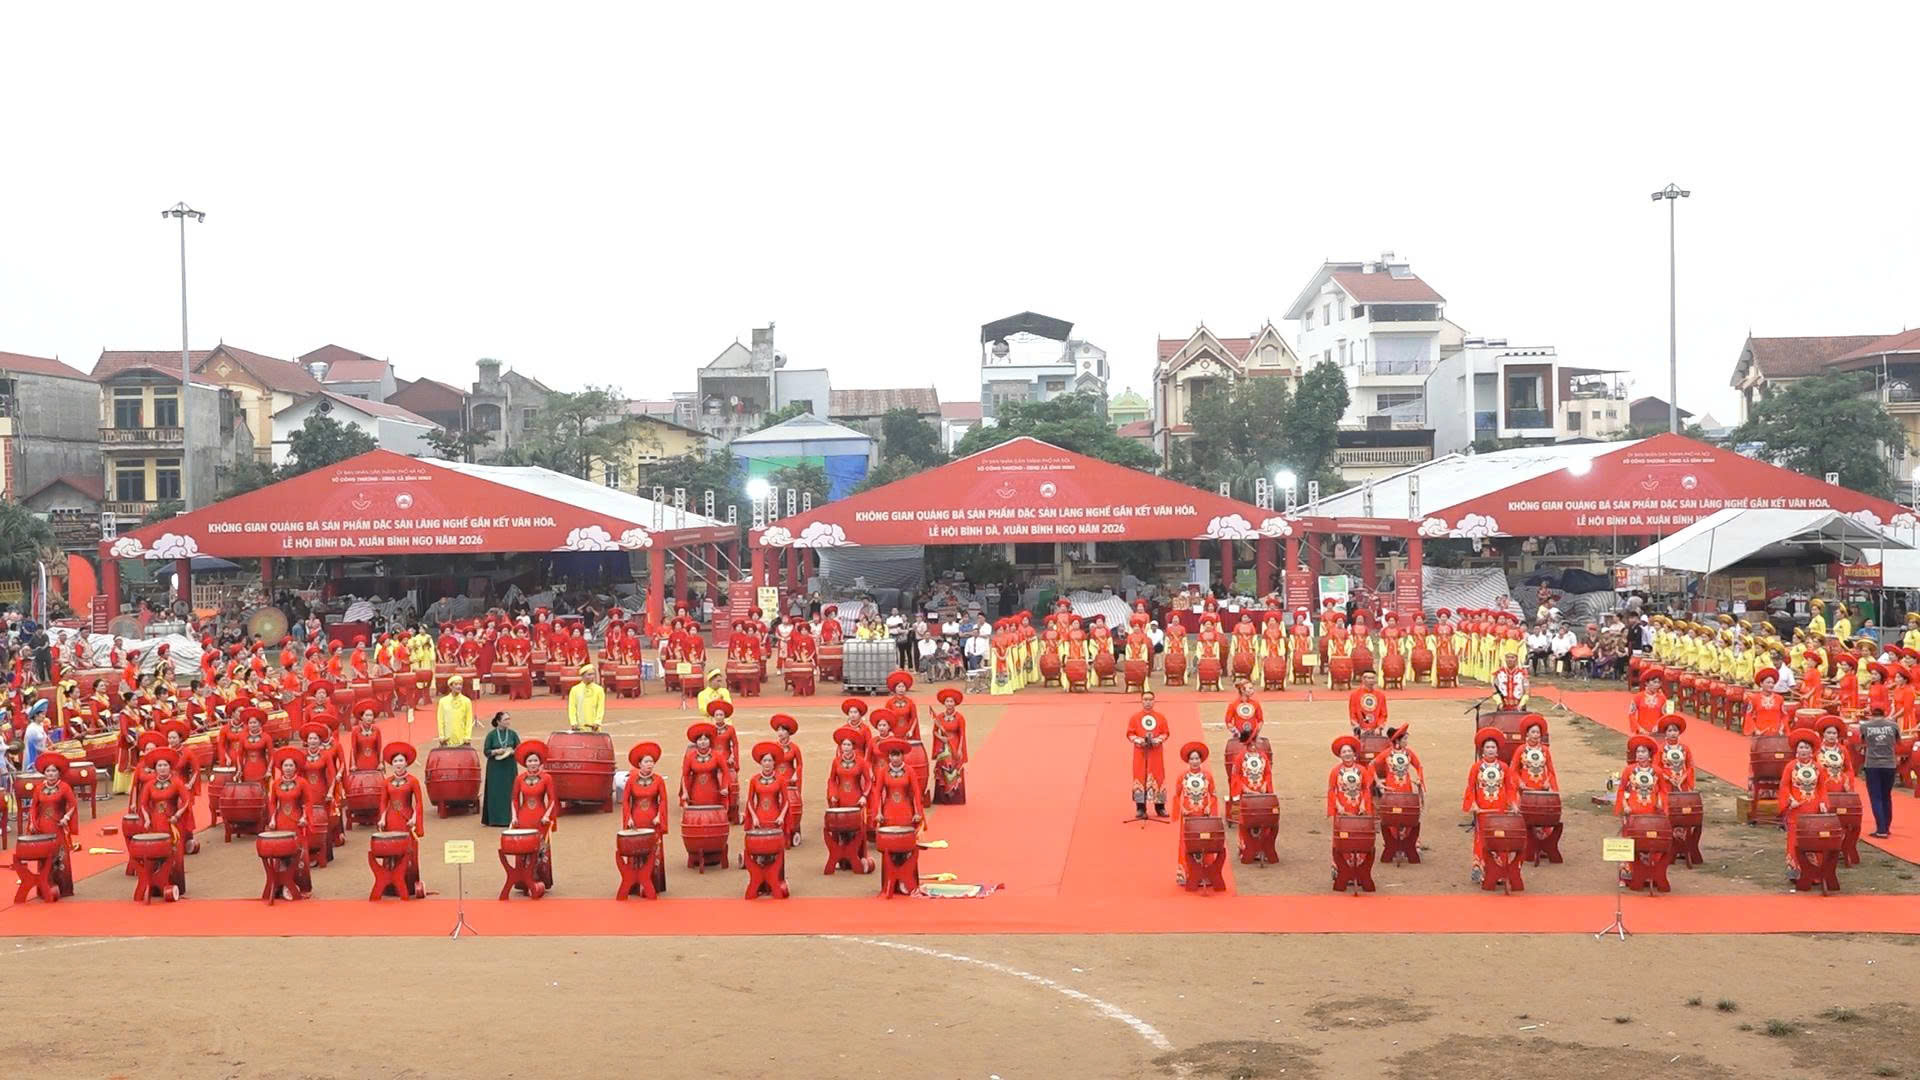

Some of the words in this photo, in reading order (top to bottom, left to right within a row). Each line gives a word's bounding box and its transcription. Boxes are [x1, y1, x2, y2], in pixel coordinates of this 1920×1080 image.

[1508, 500, 1540, 510] KHÔNG
[1541, 501, 1564, 510] GIAN
[1769, 496, 1787, 508] KẾT
[855, 510, 889, 522] KHÔNG
[891, 510, 915, 521] GIAN
[1134, 503, 1152, 517] KẾT
[208, 521, 242, 533] KHÔNG
[244, 522, 268, 533] GIAN
[492, 515, 510, 528] KẾT
[1588, 515, 1605, 527] HỘI
[1646, 514, 1671, 525] XUÂN
[940, 525, 959, 537] HỘI
[1002, 523, 1029, 536] XUÂN
[1078, 523, 1100, 534] NĂM
[1101, 523, 1126, 534] 2026
[295, 537, 313, 549] HỘI
[358, 535, 385, 547] XUÂN
[435, 534, 457, 546] NĂM
[459, 534, 484, 545] 2026
